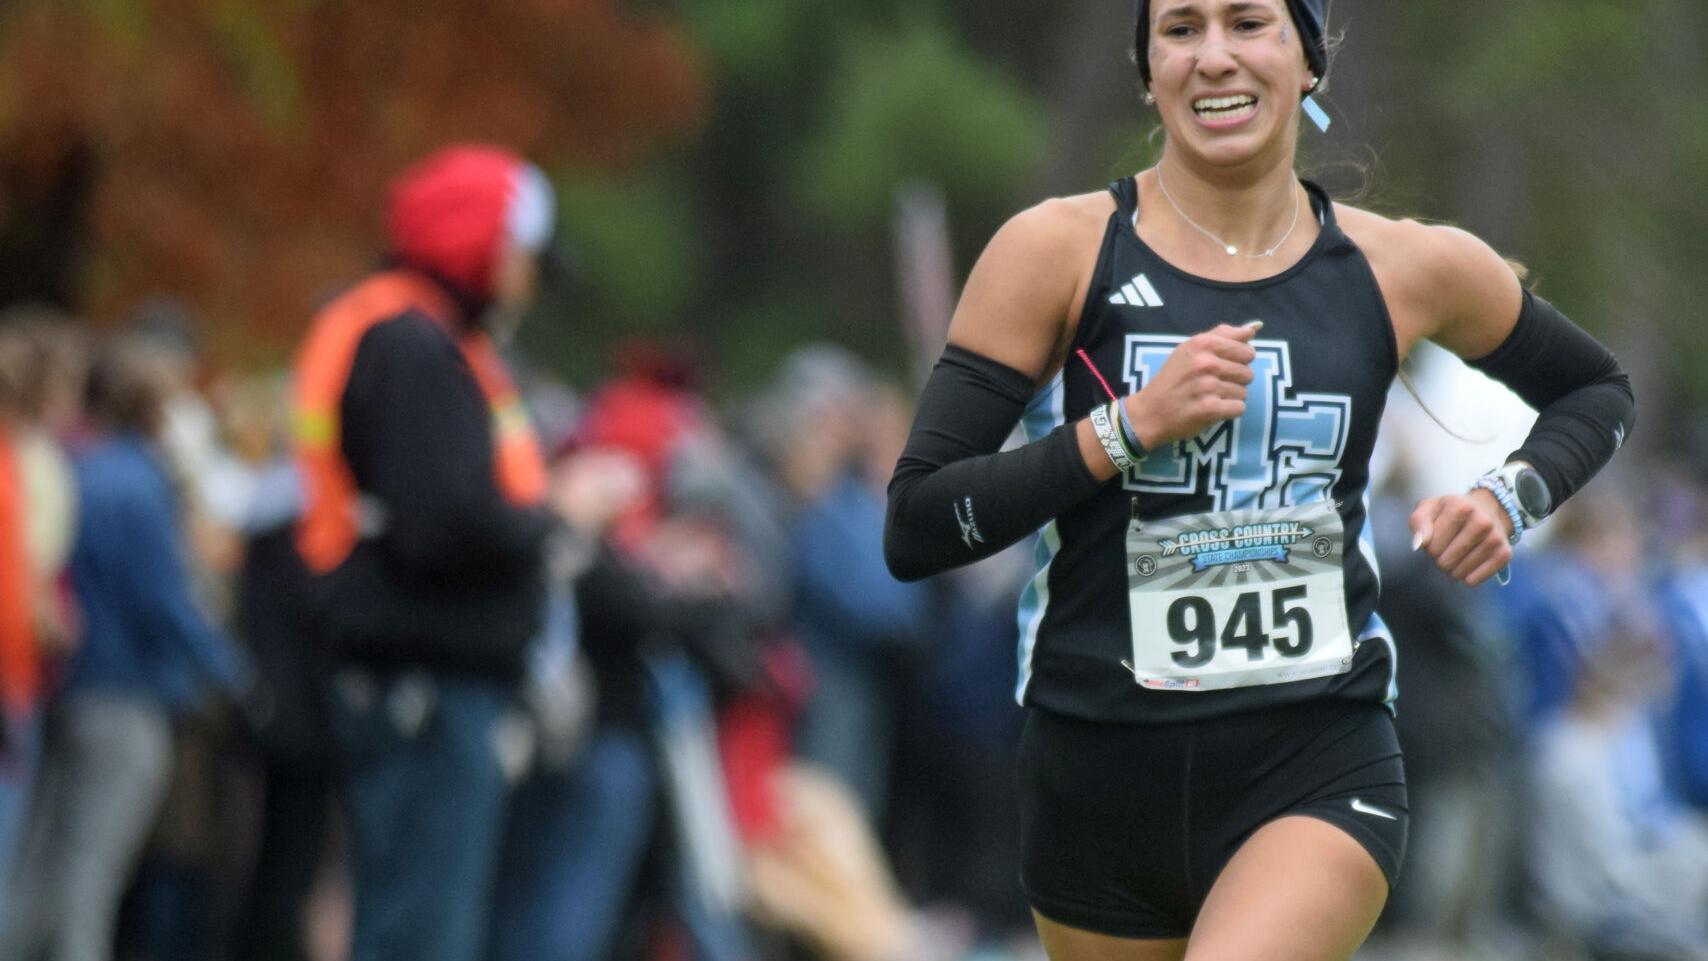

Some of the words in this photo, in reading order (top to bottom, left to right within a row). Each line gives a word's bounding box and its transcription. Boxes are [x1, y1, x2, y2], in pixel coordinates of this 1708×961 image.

[1179, 529, 1230, 555] CROSS
[1233, 522, 1299, 548] COUNTRY
[1203, 552, 1223, 563] STATE
[1166, 584, 1313, 669] 945
